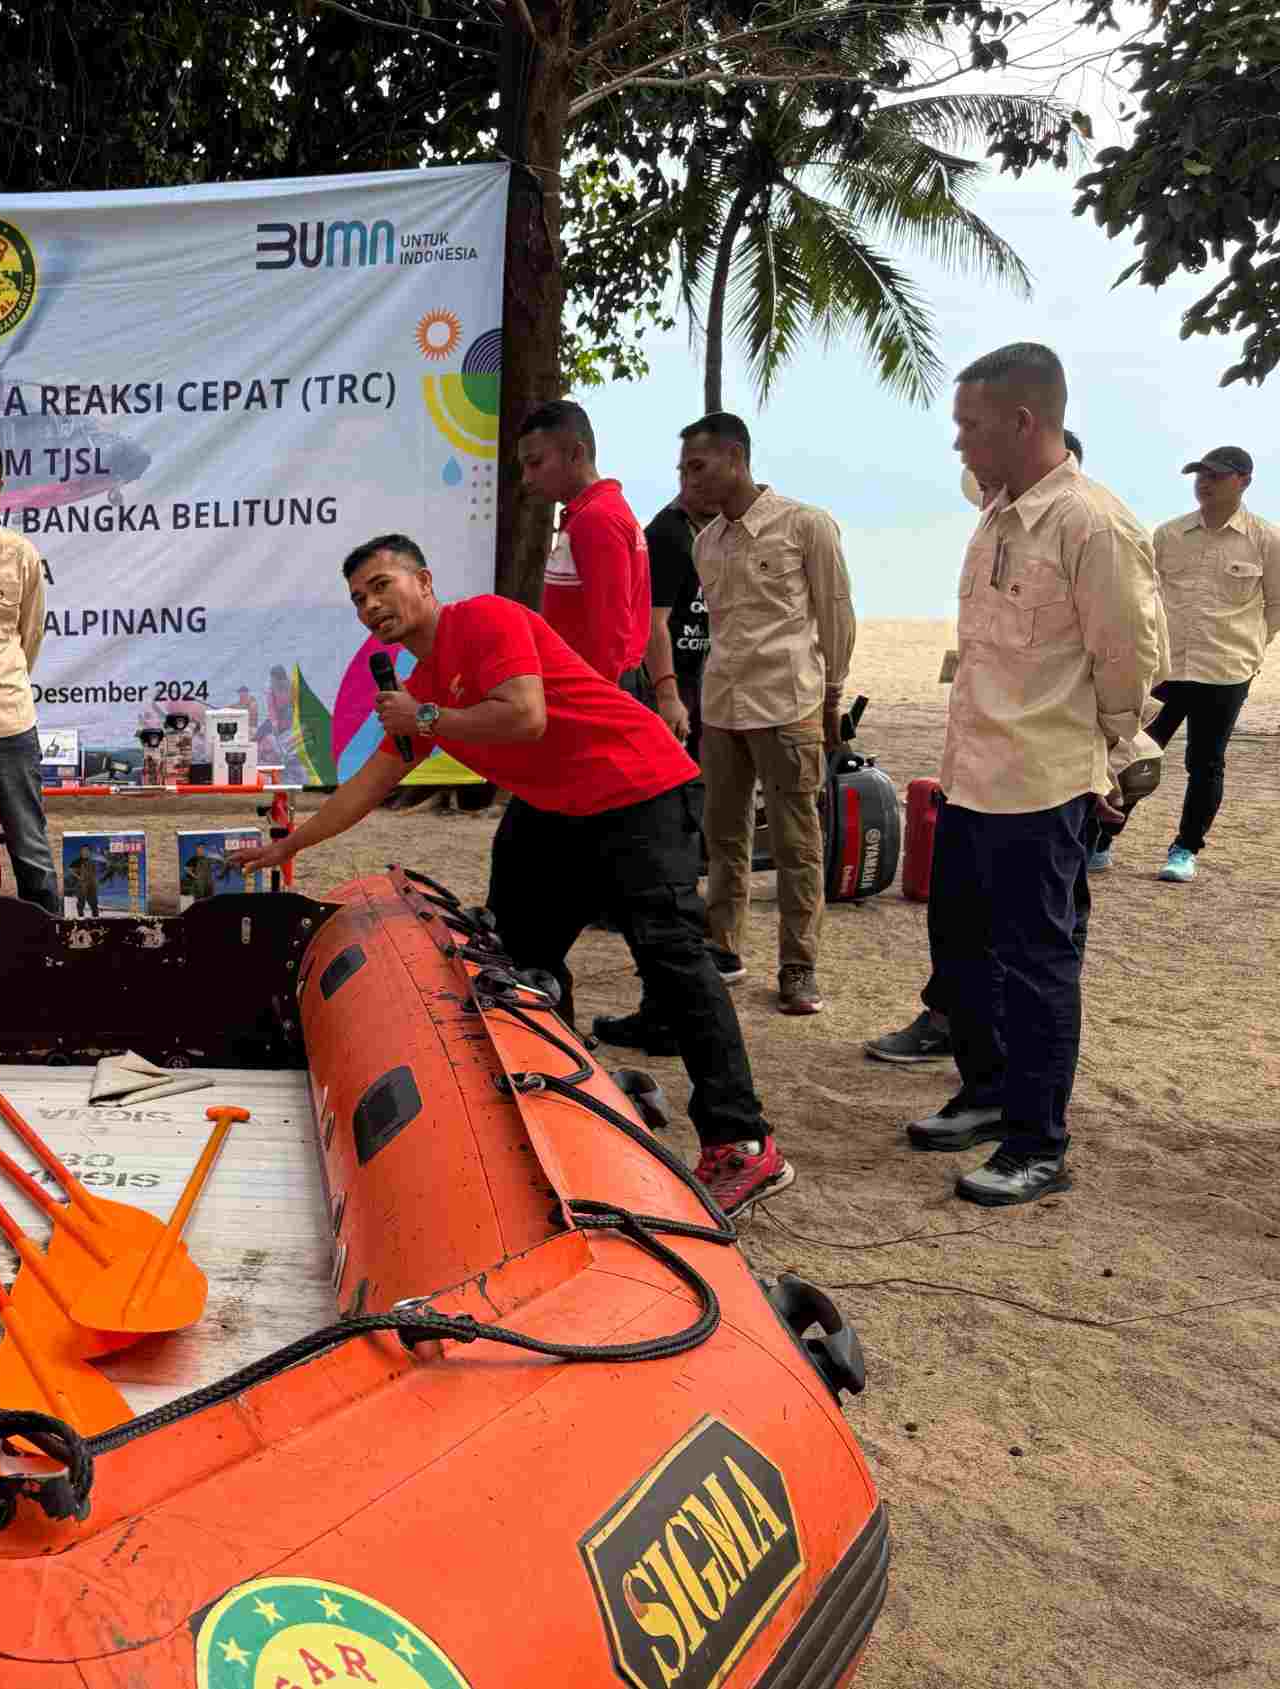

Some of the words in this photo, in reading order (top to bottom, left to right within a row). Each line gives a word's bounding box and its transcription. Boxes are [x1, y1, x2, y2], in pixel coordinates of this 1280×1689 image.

[256, 220, 395, 270] BUMN
[401, 232, 449, 249] UNTUK
[400, 248, 478, 266] INDONESIA
[41, 383, 162, 416] REAKSI
[177, 378, 290, 412] CEPAT
[302, 371, 396, 411] (TRC)
[44, 448, 110, 482] TJSL
[23, 504, 160, 533] BANGKA
[172, 496, 337, 529] BELITUNG
[43, 606, 207, 637] ALPINANG
[31, 680, 147, 706] Desember
[154, 680, 209, 704] 2024
[37, 1108, 176, 1123] SIGMA
[30, 1170, 160, 1188] SIG
[624, 1455, 788, 1688] SIGMA
